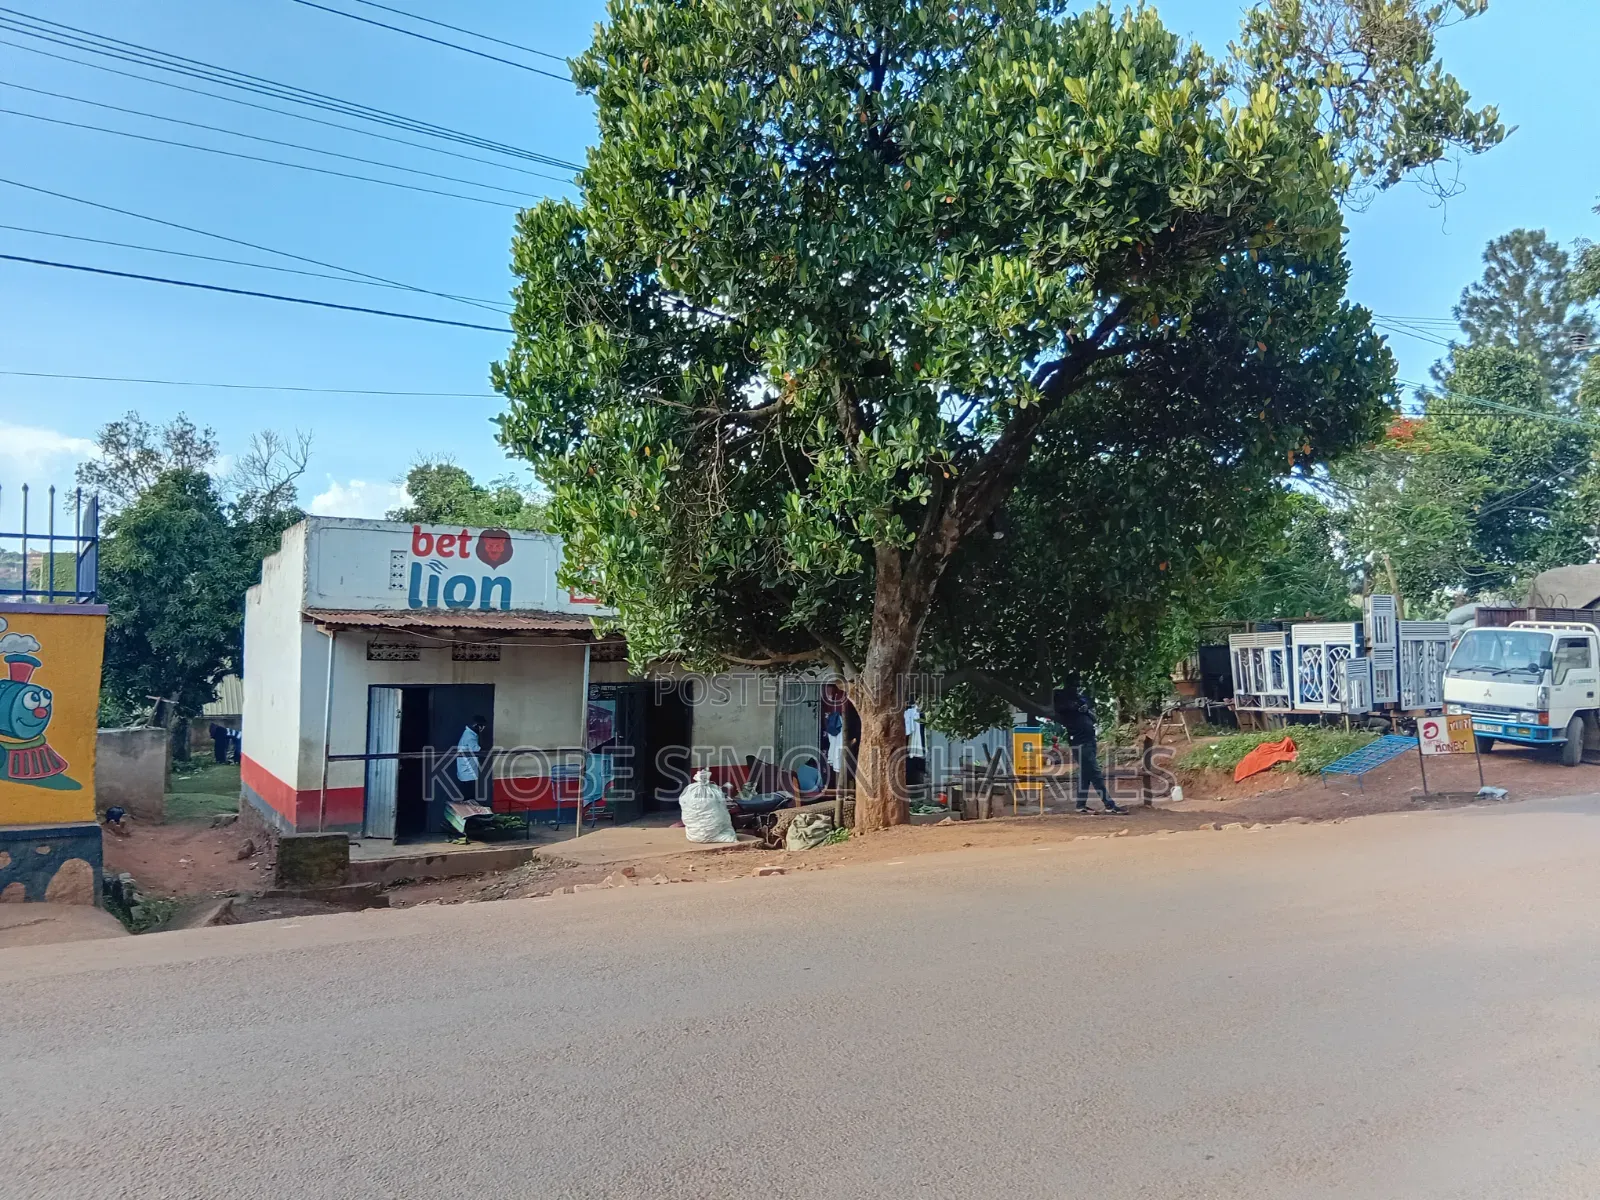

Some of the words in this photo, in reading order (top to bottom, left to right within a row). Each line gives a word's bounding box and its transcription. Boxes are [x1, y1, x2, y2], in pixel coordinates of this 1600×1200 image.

[411, 525, 472, 559] bet
[408, 560, 512, 610] lion
[1435, 740, 1468, 752] MONEY
